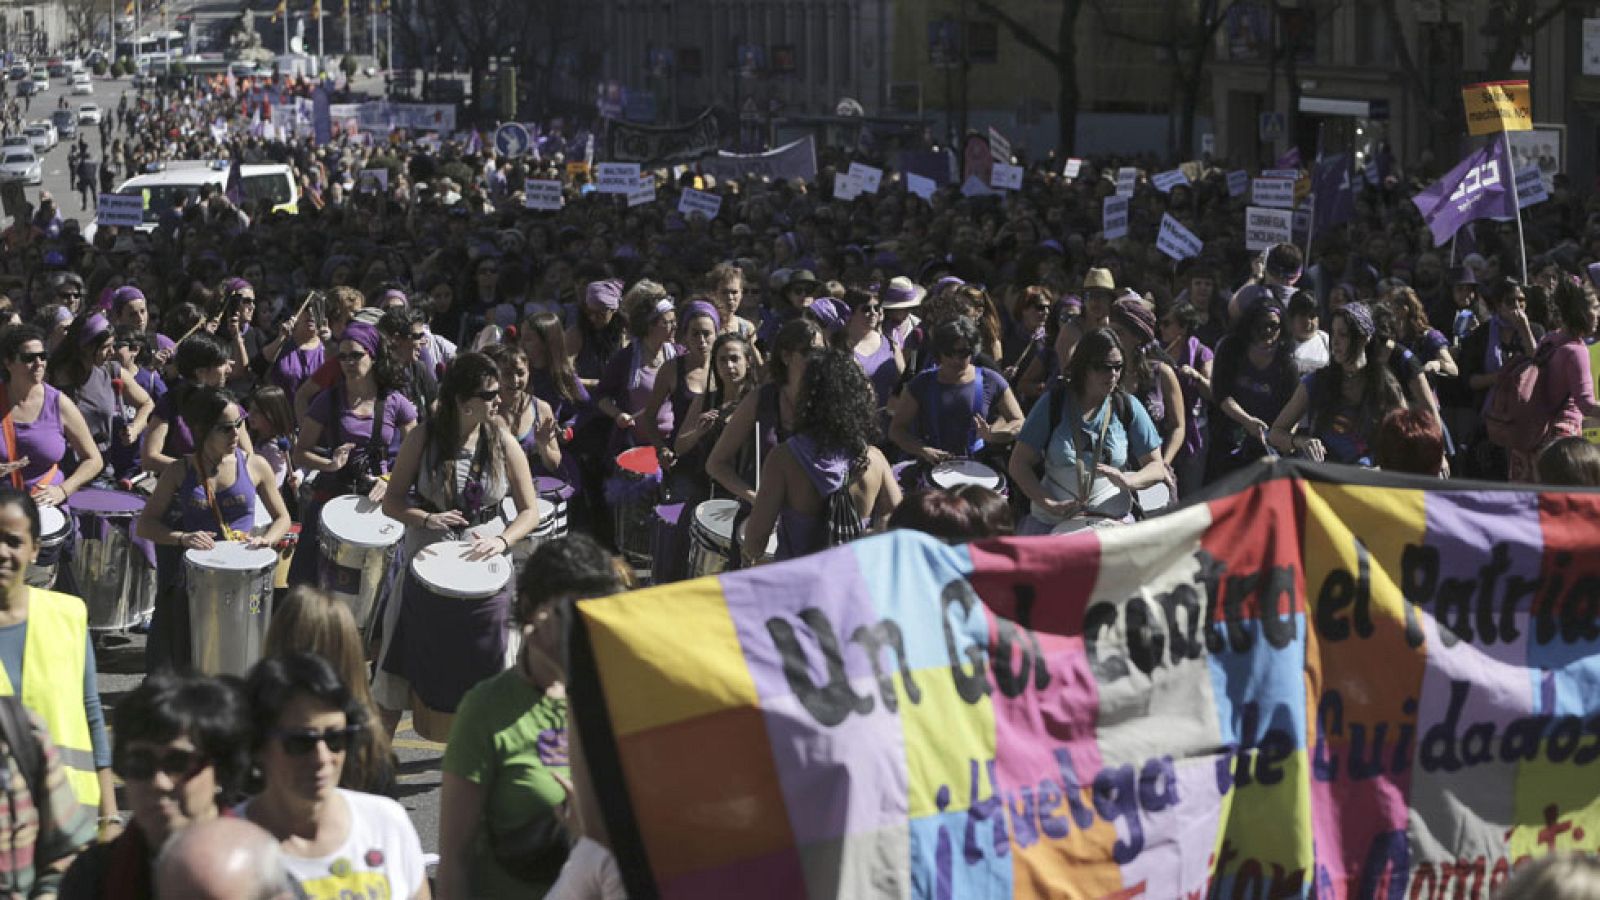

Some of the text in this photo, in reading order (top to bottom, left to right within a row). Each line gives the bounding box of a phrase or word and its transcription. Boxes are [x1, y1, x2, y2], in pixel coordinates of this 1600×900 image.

[766, 606, 922, 727] Un
[941, 579, 1052, 704] Gol
[1084, 550, 1298, 679] contra
[1317, 537, 1375, 641] el
[1216, 702, 1294, 796] de
